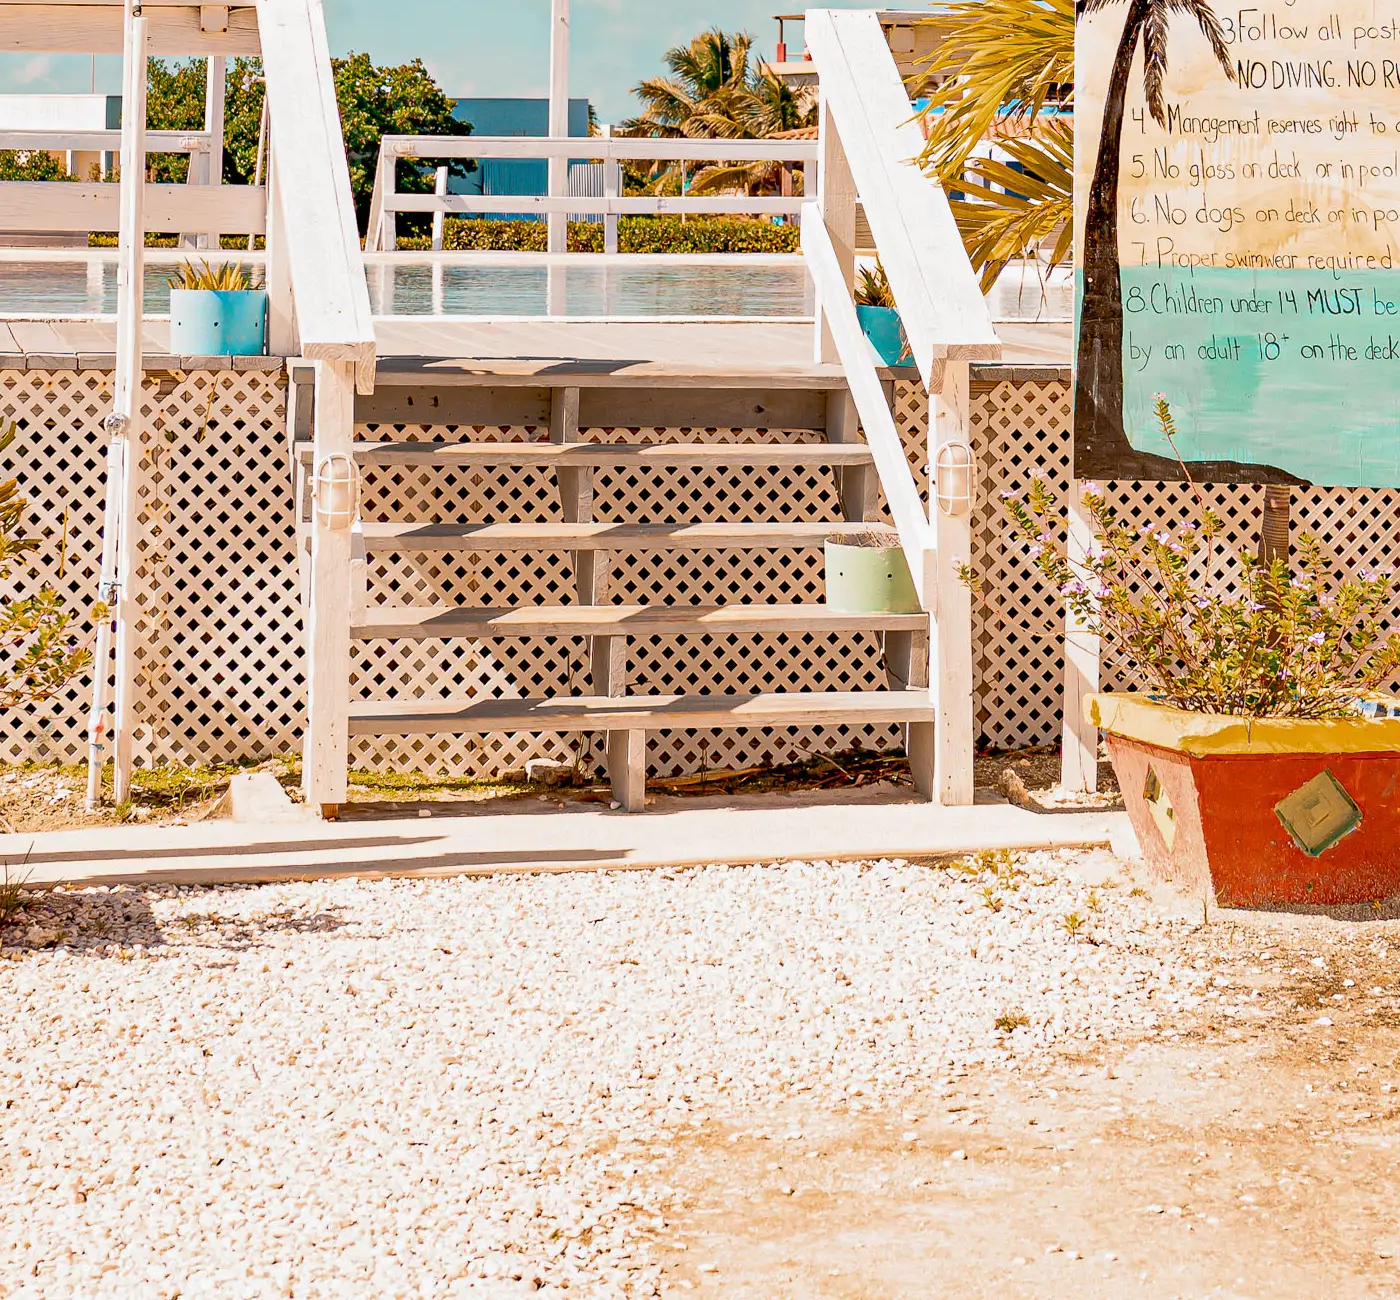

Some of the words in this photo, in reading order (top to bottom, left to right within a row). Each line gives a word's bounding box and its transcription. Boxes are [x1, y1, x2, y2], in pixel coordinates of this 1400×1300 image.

[1239, 8, 1308, 43] Follow
[1318, 14, 1342, 41] all
[1354, 18, 1400, 50] post
[1237, 59, 1267, 89] NO
[1272, 60, 1341, 89] DIVING.
[1347, 59, 1376, 88] NO
[1167, 103, 1260, 143] Management
[1267, 118, 1322, 135] reserves
[1329, 110, 1358, 140] right
[1369, 112, 1386, 134] to
[1131, 154, 1148, 179] 5.
[1154, 146, 1180, 179] No
[1189, 148, 1235, 187] glass
[1242, 162, 1262, 179] on
[1268, 149, 1302, 179] deck
[1315, 163, 1332, 178] or
[1340, 159, 1353, 178] in
[1359, 150, 1398, 187] pool
[1131, 196, 1150, 224] 6.
[1154, 193, 1187, 225] No
[1195, 192, 1246, 233] dogs
[1255, 208, 1279, 223] on
[1284, 198, 1321, 224] deck
[1327, 209, 1345, 223] or
[1351, 207, 1368, 224] in
[1131, 241, 1148, 267] 7.
[1156, 236, 1219, 278] Proper
[1224, 250, 1299, 269] swimwear
[1307, 243, 1392, 280] required
[1150, 282, 1224, 315] Children
[1230, 288, 1273, 313] under
[1278, 289, 1298, 314] 14
[1307, 287, 1363, 316] MUST
[1373, 286, 1398, 316] be
[1129, 330, 1152, 372] by
[1164, 343, 1185, 361] an
[1197, 333, 1241, 361] adult
[1258, 332, 1290, 361] 18+
[1300, 344, 1324, 359] on
[1328, 332, 1358, 361] the
[1364, 335, 1400, 361] deck
